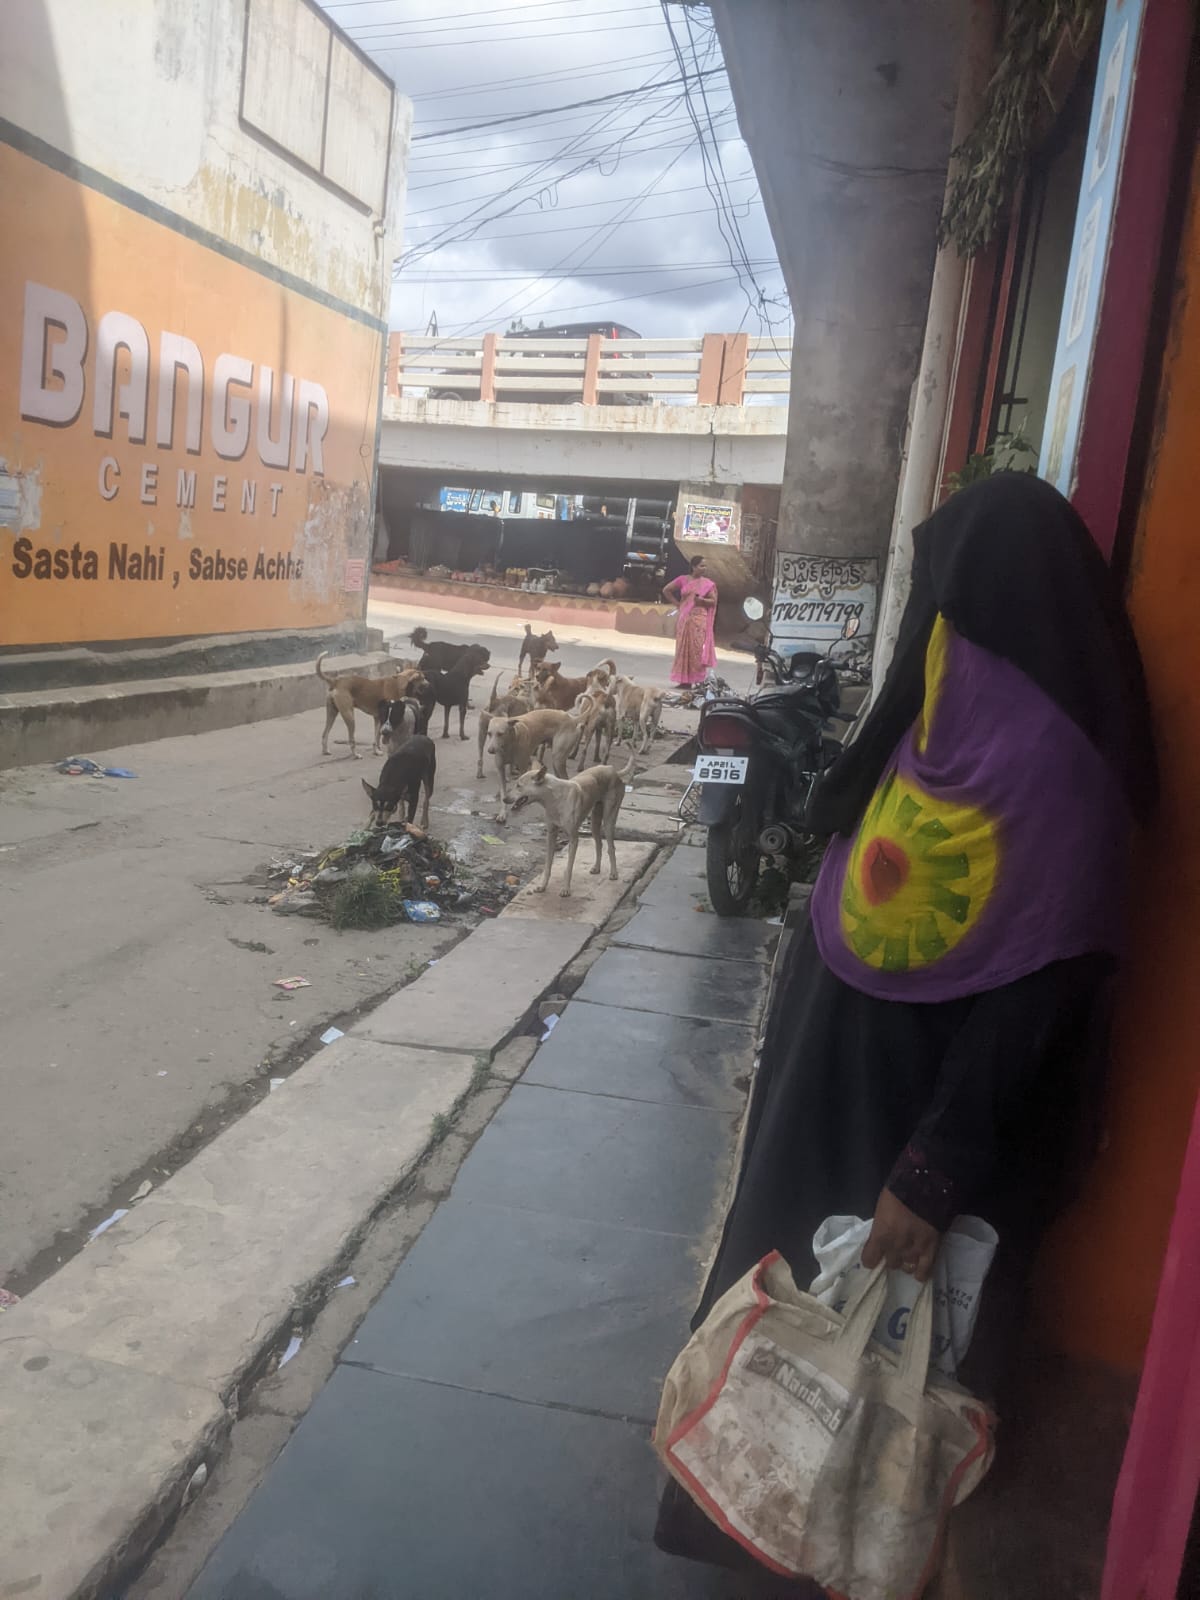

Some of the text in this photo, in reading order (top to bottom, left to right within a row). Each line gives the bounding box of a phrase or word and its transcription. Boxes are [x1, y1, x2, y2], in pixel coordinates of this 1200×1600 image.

[20, 280, 329, 476] BANGUR
[100, 456, 283, 516] CEMENT
[12, 537, 98, 579] Sasta
[189, 548, 248, 580] Sabse
[773, 602, 864, 621] 7702779799
[699, 768, 740, 780] 8916
